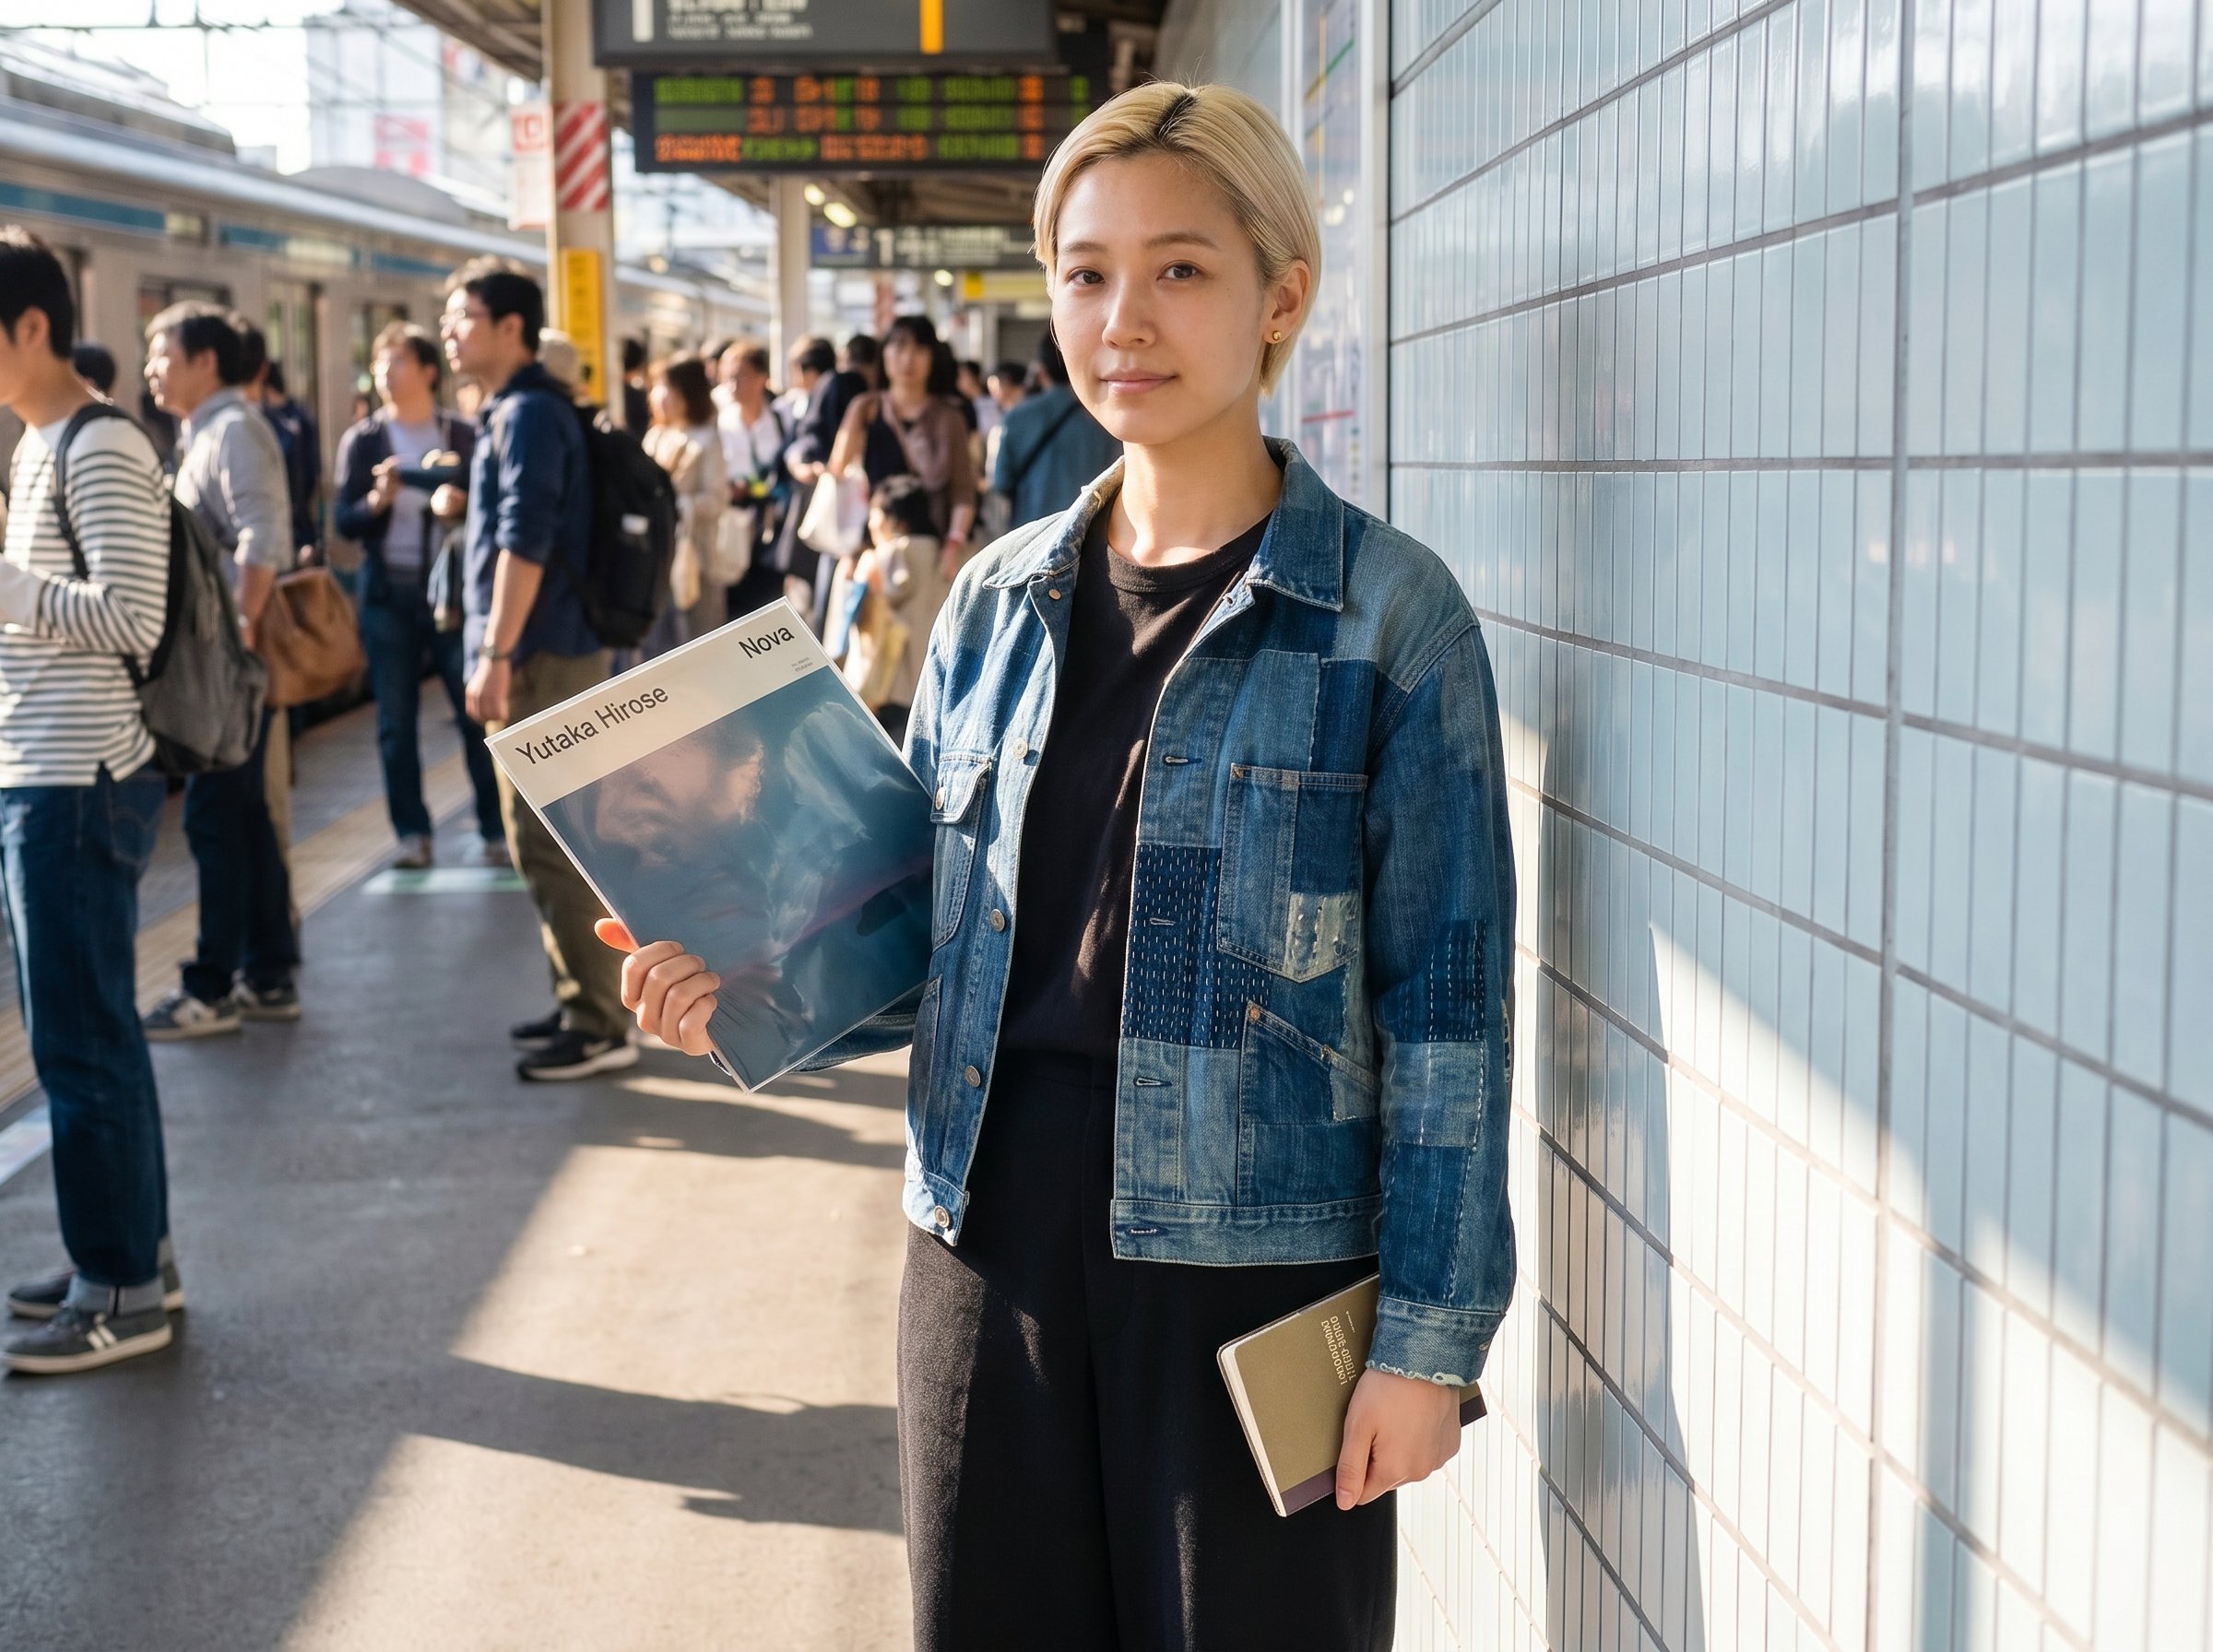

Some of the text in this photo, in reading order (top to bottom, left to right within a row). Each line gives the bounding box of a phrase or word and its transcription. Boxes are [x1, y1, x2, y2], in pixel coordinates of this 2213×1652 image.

[739, 626, 795, 659] Nova
[515, 687, 669, 764] Yutaka Hirose
